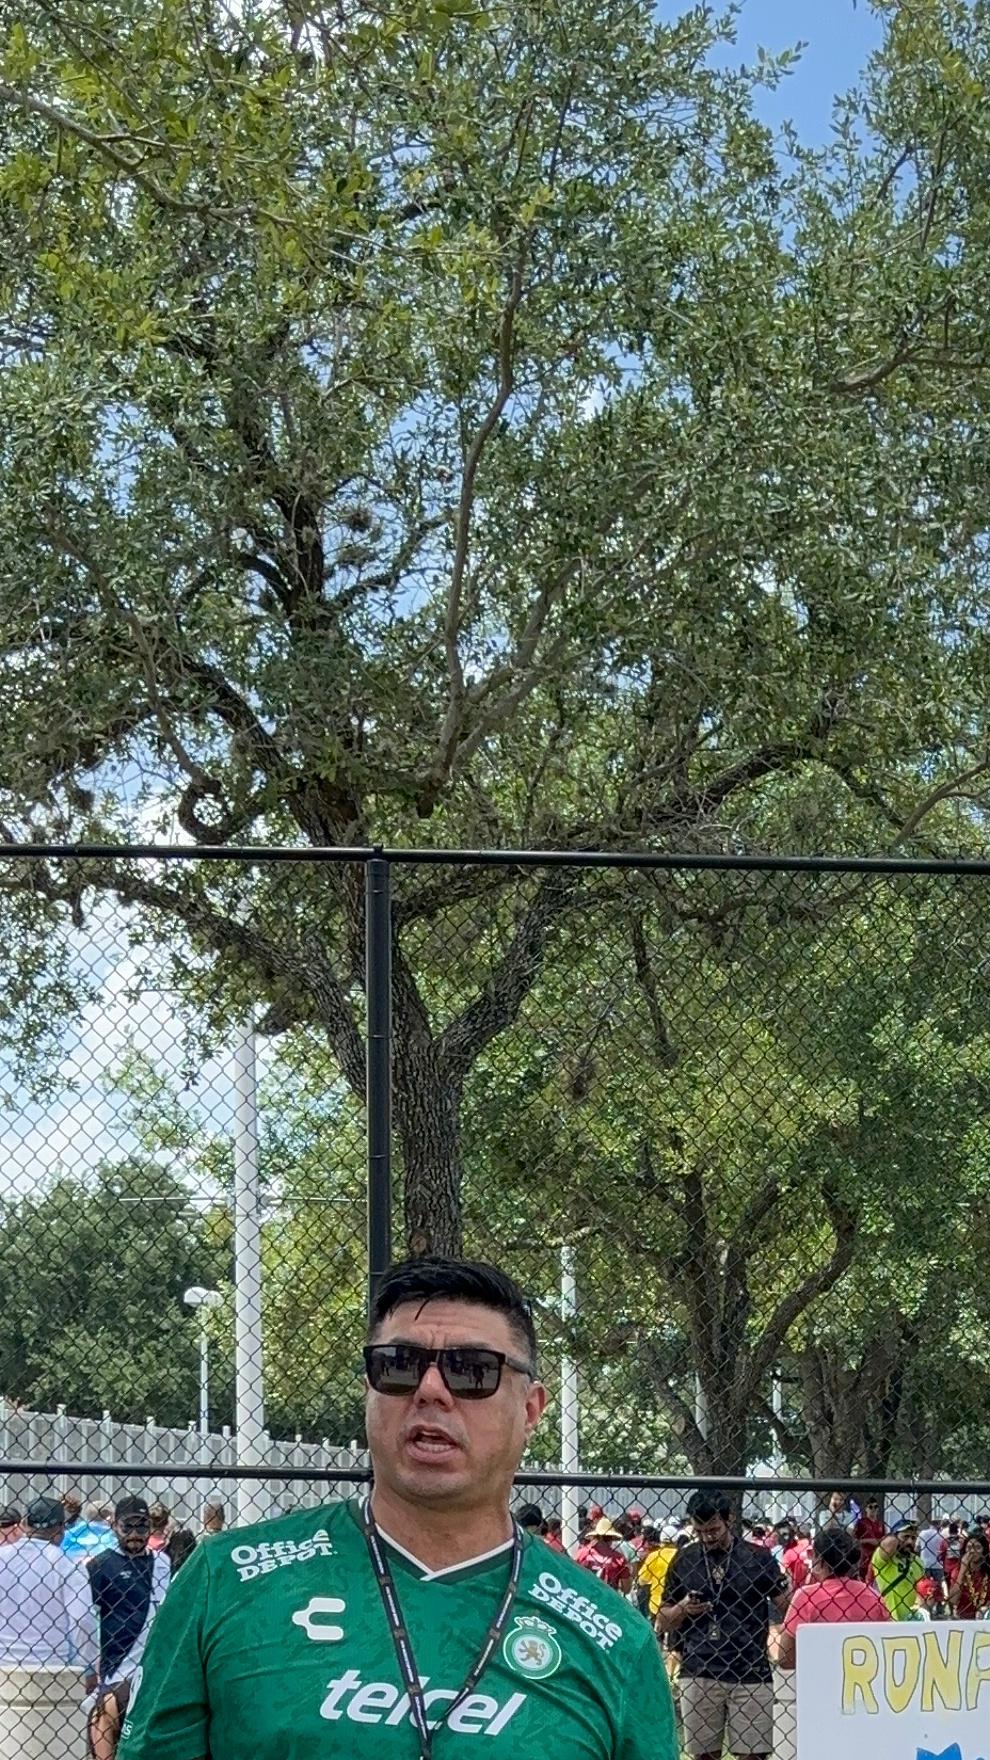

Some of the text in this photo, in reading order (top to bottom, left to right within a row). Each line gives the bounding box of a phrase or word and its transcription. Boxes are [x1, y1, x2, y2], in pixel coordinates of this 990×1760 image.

[231, 1529, 330, 1565] Office
[539, 1572, 622, 1641] Office
[319, 1669, 528, 1736] telcel
